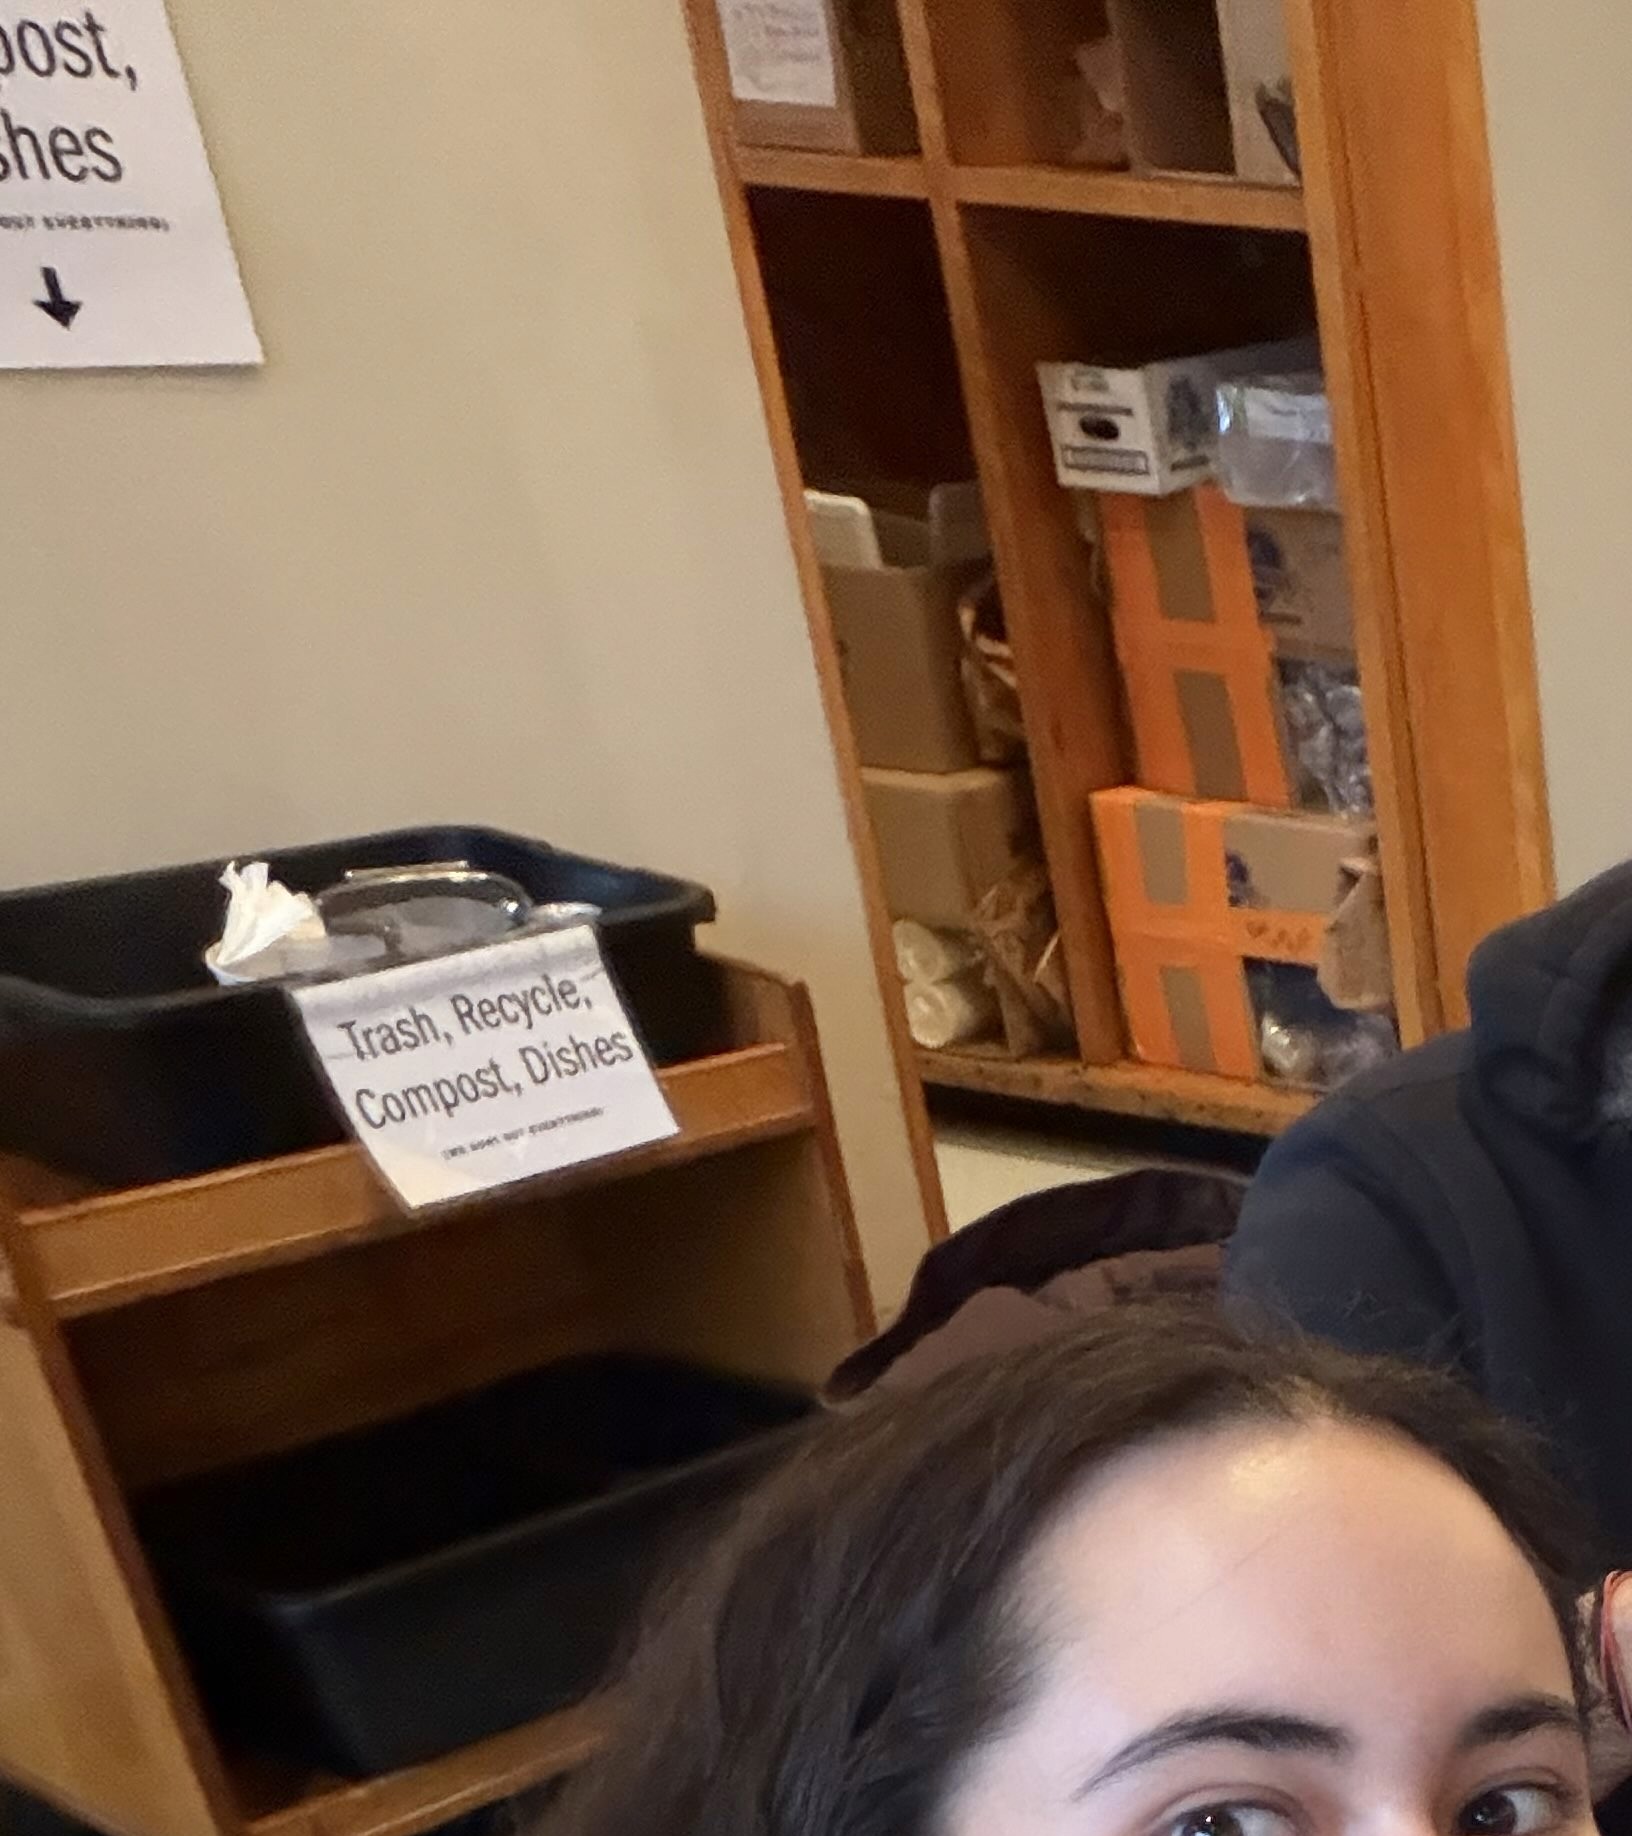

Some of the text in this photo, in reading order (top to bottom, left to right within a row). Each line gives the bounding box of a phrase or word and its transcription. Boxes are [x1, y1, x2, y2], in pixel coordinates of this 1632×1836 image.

[337, 973, 594, 1061] Trash, Recycle,
[354, 1029, 635, 1130] Compost, Dishes
